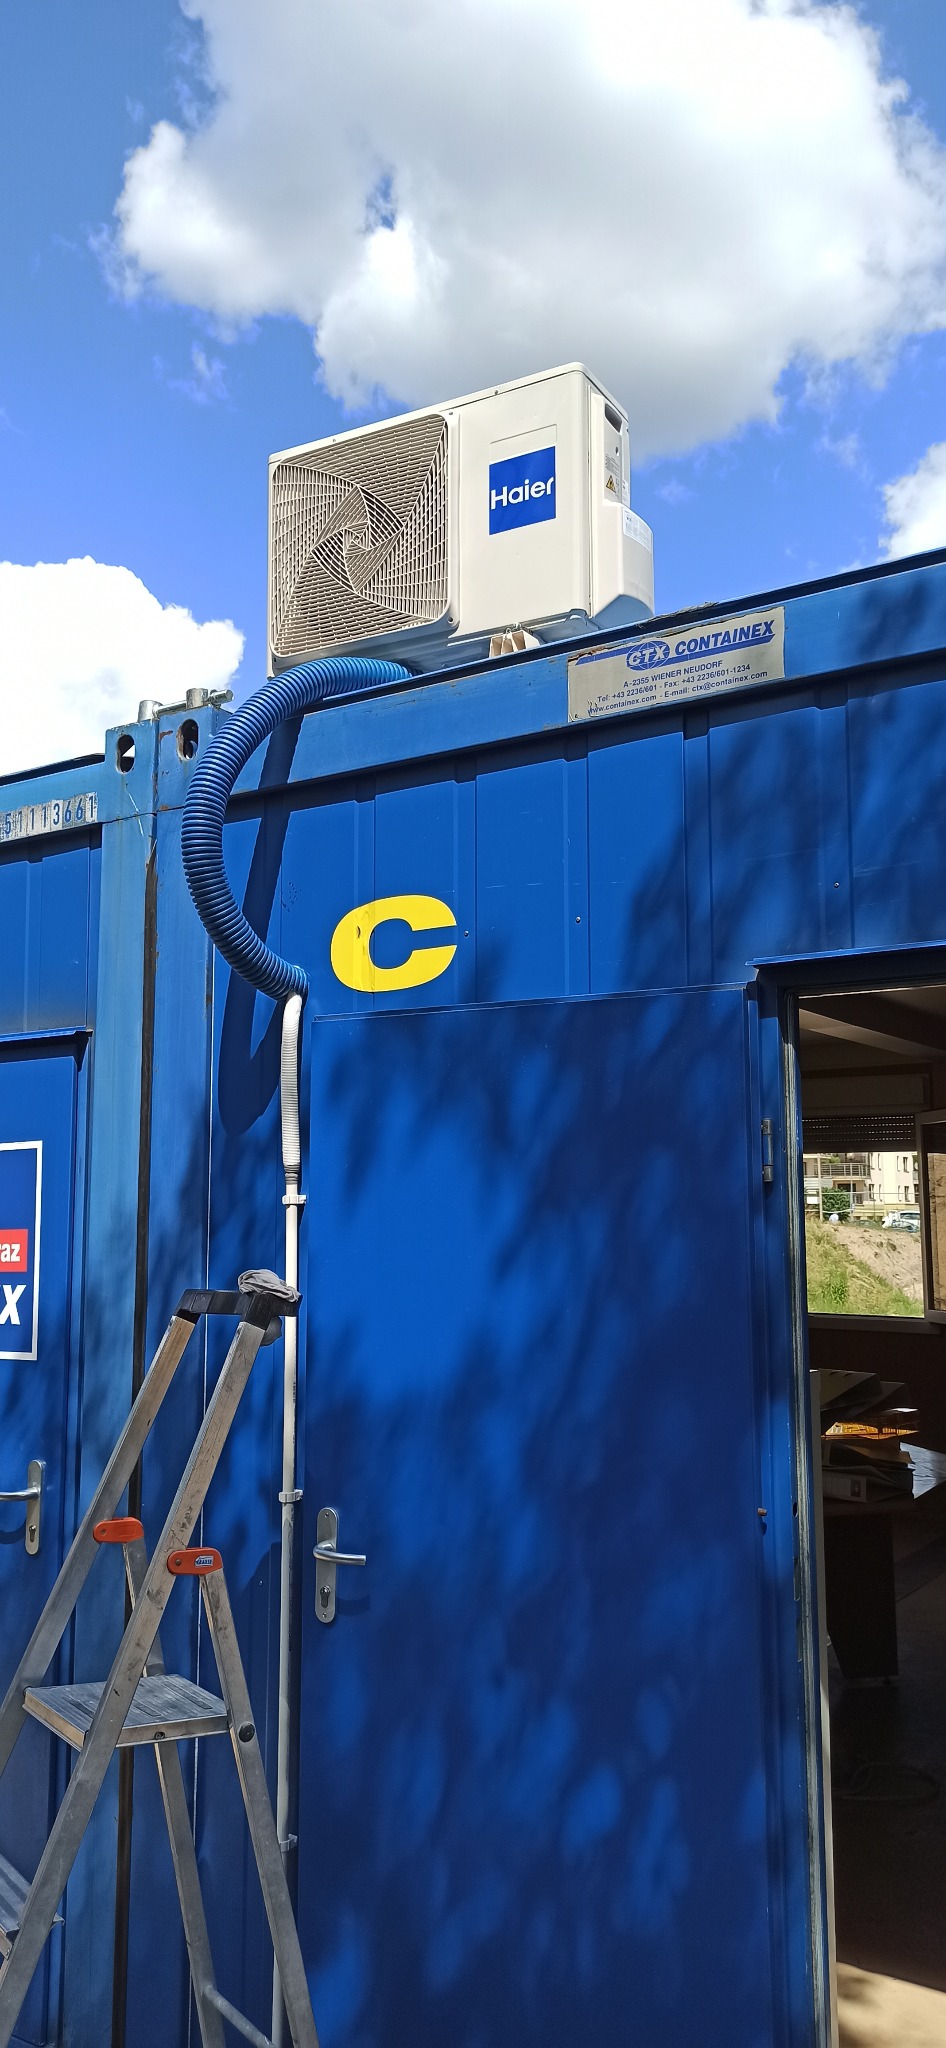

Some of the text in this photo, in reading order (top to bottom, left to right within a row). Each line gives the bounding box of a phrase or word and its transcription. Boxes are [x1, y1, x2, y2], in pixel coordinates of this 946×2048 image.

[490, 477, 554, 510] Haier
[628, 619, 775, 666] CTX CONTAINEX
[597, 695, 610, 703] Tel:
[612, 691, 625, 699] +43
[627, 684, 657, 697] 2236/601
[664, 680, 679, 689] Fax:
[681, 676, 694, 684] +43
[623, 660, 723, 689] A-2355 WIENER NEUDORF
[664, 687, 690, 698] E-mail:
[692, 671, 768, 691] ctx@containex.com
[330, 894, 458, 993] C
